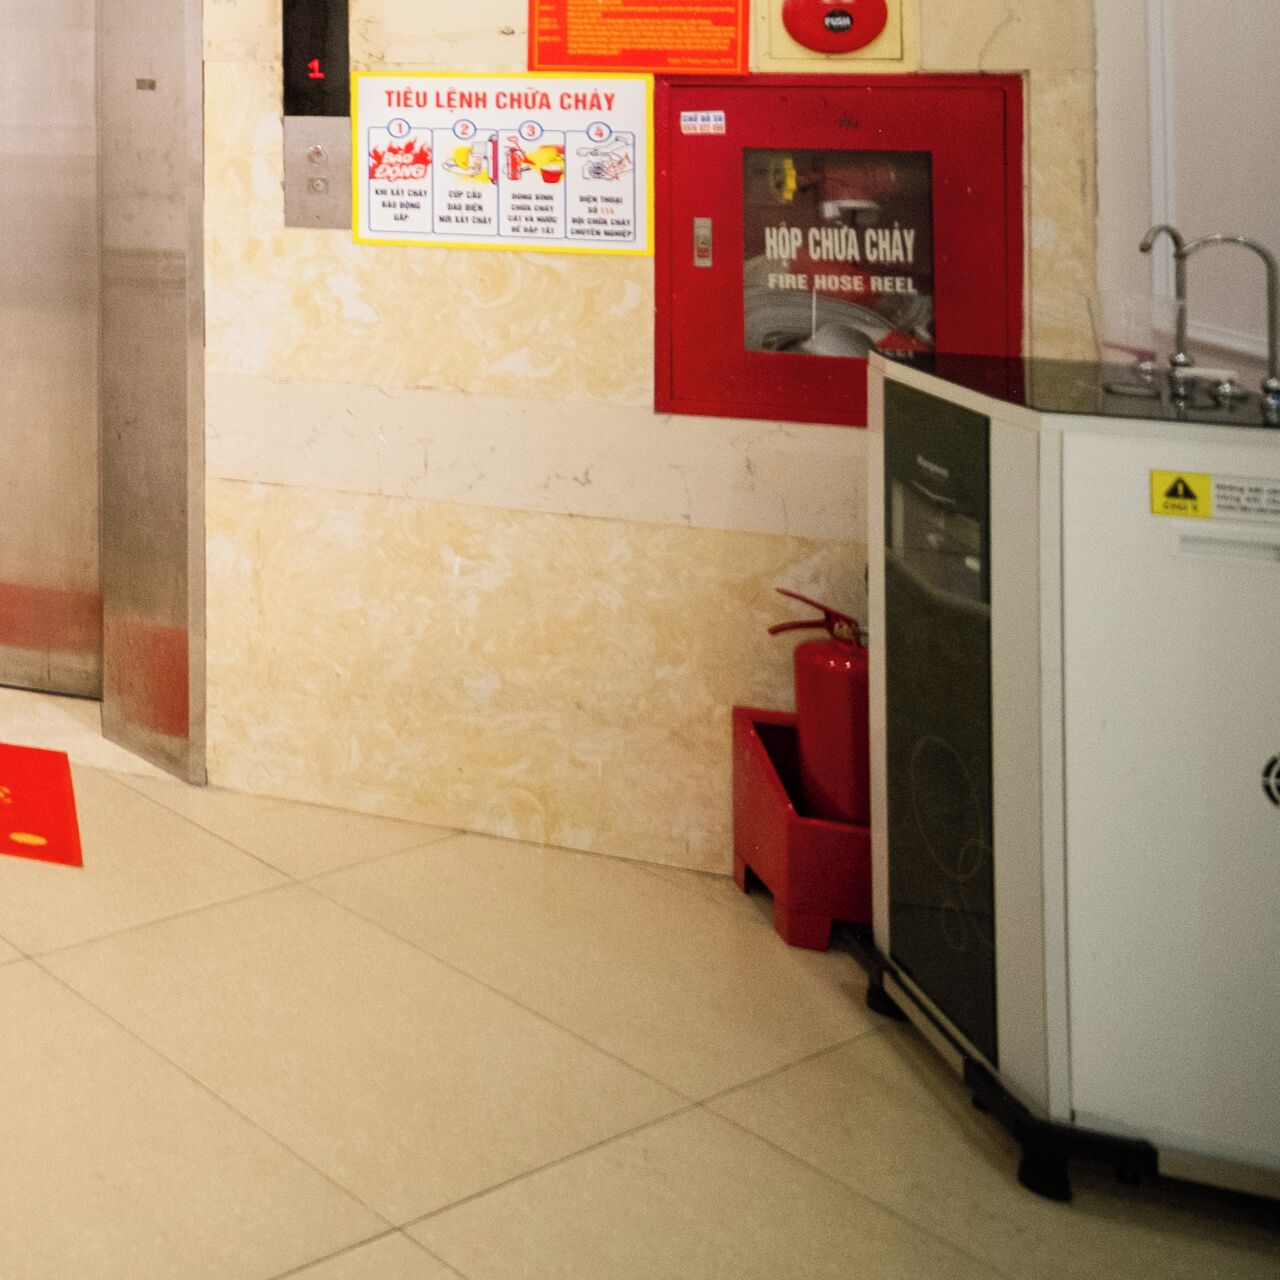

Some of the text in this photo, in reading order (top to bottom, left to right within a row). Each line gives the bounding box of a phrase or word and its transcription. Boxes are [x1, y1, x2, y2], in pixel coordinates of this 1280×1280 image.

[307, 58, 325, 79] 1
[385, 86, 616, 113] TIÊU LỆNH CHỮA CHÁY
[397, 122, 403, 134] 1
[461, 124, 469, 134] 2
[527, 125, 535, 136] 3
[594, 127, 603, 137] 4
[768, 273, 918, 294] FIRE HOSE REEL
